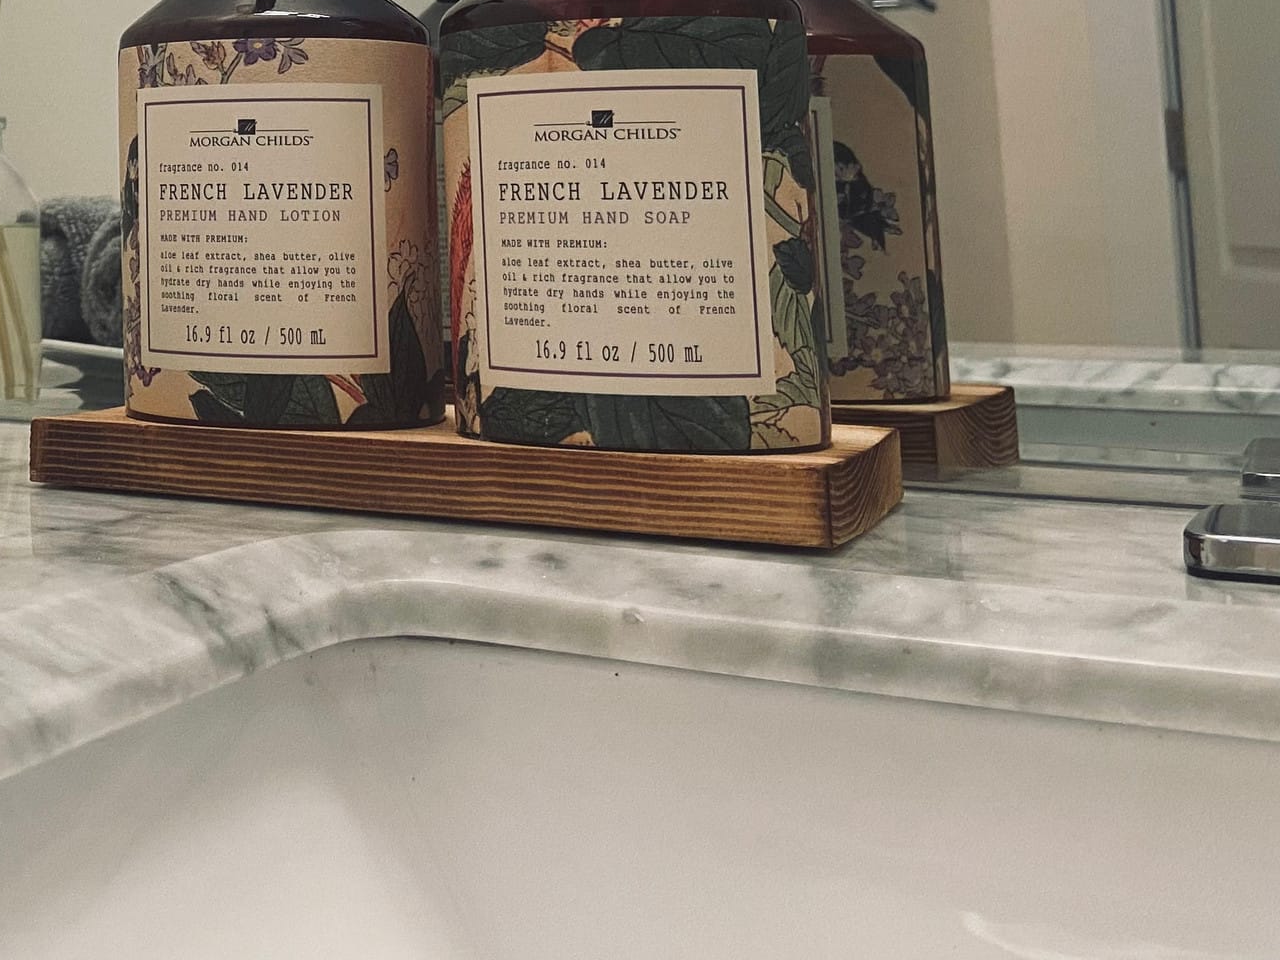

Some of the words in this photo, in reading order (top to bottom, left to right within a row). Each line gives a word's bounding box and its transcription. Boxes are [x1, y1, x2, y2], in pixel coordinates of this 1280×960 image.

[534, 128, 607, 142] MORGAN
[189, 136, 251, 147] MORGAN
[160, 163, 202, 174] fragrance
[208, 163, 223, 172] no.
[232, 162, 248, 171] 014
[498, 160, 550, 172] fragrance
[557, 160, 576, 169] no.
[585, 158, 605, 168] 014
[160, 184, 226, 200] FRENCH
[243, 183, 353, 200] LAVENDER
[499, 182, 580, 201] FRENCH
[600, 181, 729, 200] LAVENDER
[160, 210, 216, 221] PREMIUM
[229, 210, 267, 221] HAND
[280, 210, 340, 222] LOTION
[500, 211, 568, 225] PREMIUM
[583, 211, 629, 224] HAND
[645, 211, 690, 224] SOAP
[181, 234, 200, 242] WITH
[206, 235, 248, 243] PREMIUM:
[502, 239, 522, 248] MADE
[527, 239, 550, 248] WITH
[557, 240, 607, 248] PREMIUM:
[182, 252, 199, 260] leaf
[205, 253, 246, 261] extract,
[283, 252, 320, 261] butter,
[329, 252, 355, 261] olive
[502, 257, 521, 267] aloe
[528, 258, 549, 267] leaf
[557, 259, 605, 269] extract,
[615, 259, 640, 268] shea
[650, 259, 694, 269] butter,
[703, 259, 733, 268] olive
[161, 264, 172, 272] oil
[185, 265, 203, 273] rich
[209, 265, 256, 275] fragrance
[263, 266, 284, 274] that
[291, 266, 319, 274] allow
[324, 267, 341, 276] you
[196, 279, 210, 289] dry
[218, 279, 244, 287] hands
[252, 279, 280, 288] while
[288, 280, 332, 290] enjoying
[341, 280, 355, 288] the
[502, 272, 516, 281] oil
[533, 273, 555, 282] rich
[562, 273, 619, 285] fragrance
[626, 274, 652, 283] that
[659, 274, 692, 283] allow
[698, 276, 716, 285] you
[723, 274, 734, 283] to
[208, 292, 238, 301] floral
[255, 294, 282, 302] scent
[298, 294, 308, 302] of
[325, 294, 356, 302] French
[504, 287, 538, 298] hydrate
[546, 288, 563, 300] dry
[573, 289, 604, 298] hands
[614, 289, 647, 298] while
[657, 289, 708, 301] enjoying
[718, 290, 734, 299] the
[504, 302, 544, 313] soothing
[562, 303, 598, 313] floral
[617, 305, 650, 314] scent
[669, 305, 680, 314] of
[700, 305, 735, 314] French
[186, 325, 210, 343] 16.9
[220, 326, 232, 343] fl
[241, 330, 255, 344] oz
[265, 326, 270, 345] /
[280, 328, 301, 345] 500
[311, 329, 326, 344] mL
[536, 340, 566, 359] 16.9
[576, 341, 592, 360] fl
[602, 345, 619, 361] oz
[631, 341, 637, 363] /
[649, 343, 674, 362] 500
[684, 344, 702, 362] mL
